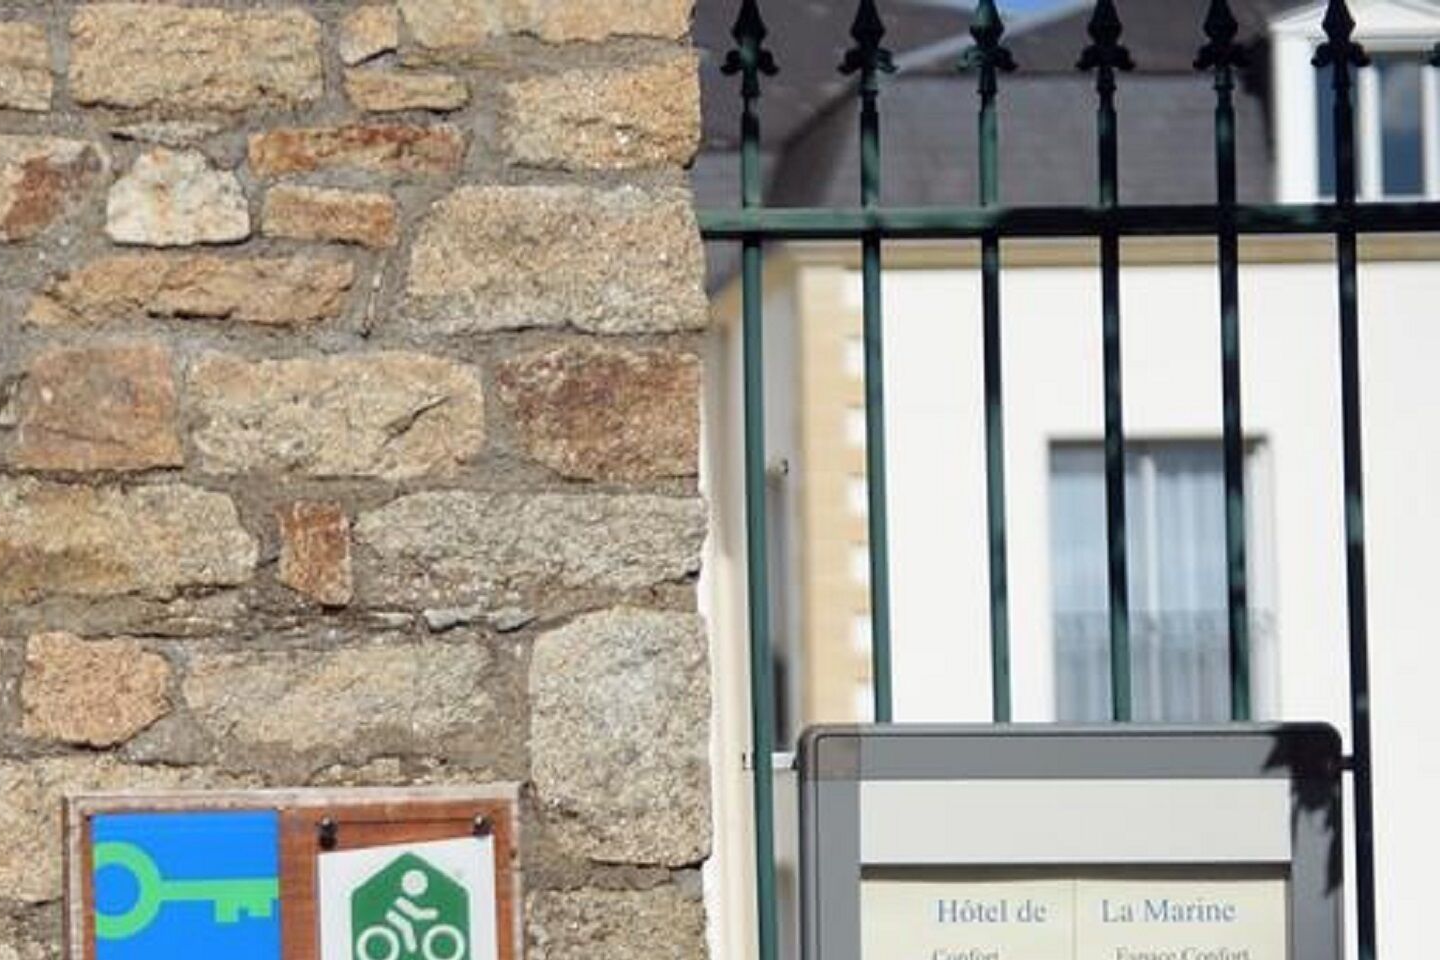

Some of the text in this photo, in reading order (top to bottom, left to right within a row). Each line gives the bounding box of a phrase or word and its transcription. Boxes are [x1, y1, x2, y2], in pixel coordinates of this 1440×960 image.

[937, 899, 1236, 923] Hôtel de La Marine
